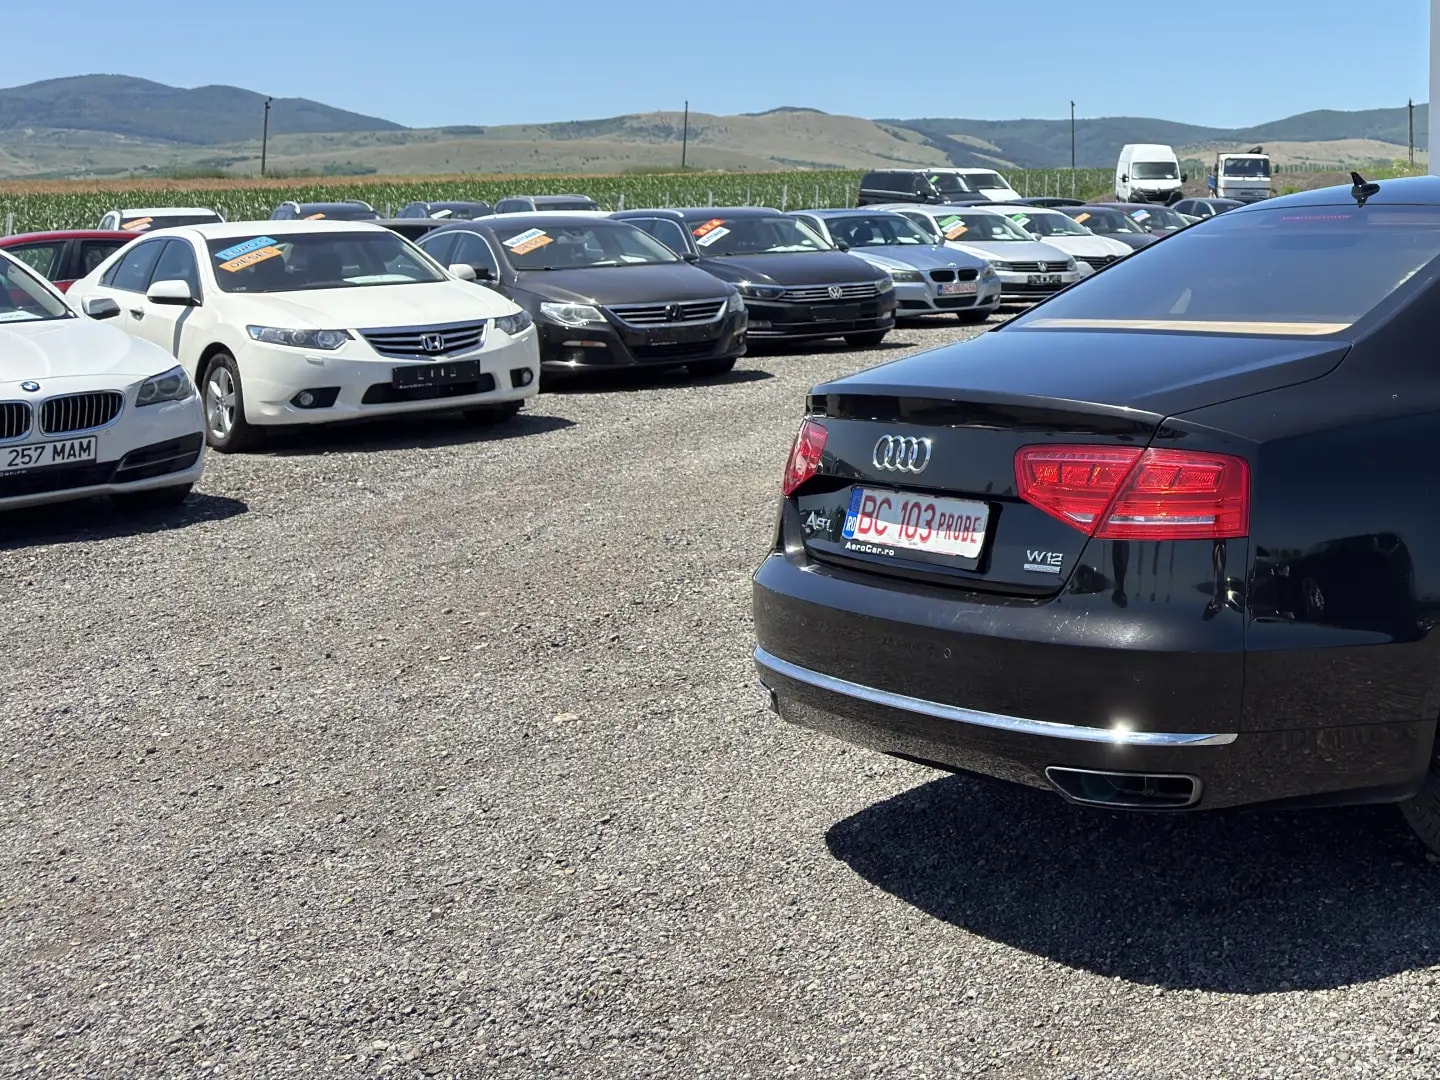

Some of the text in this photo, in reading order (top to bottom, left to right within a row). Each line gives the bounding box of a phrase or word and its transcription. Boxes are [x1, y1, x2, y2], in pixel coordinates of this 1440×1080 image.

[7, 439, 92, 467] 257 MAM
[846, 516, 858, 532] RO
[857, 495, 982, 543] BC 103 PROBE
[844, 541, 895, 556] AeroCar.ro
[1026, 549, 1064, 565] W12
